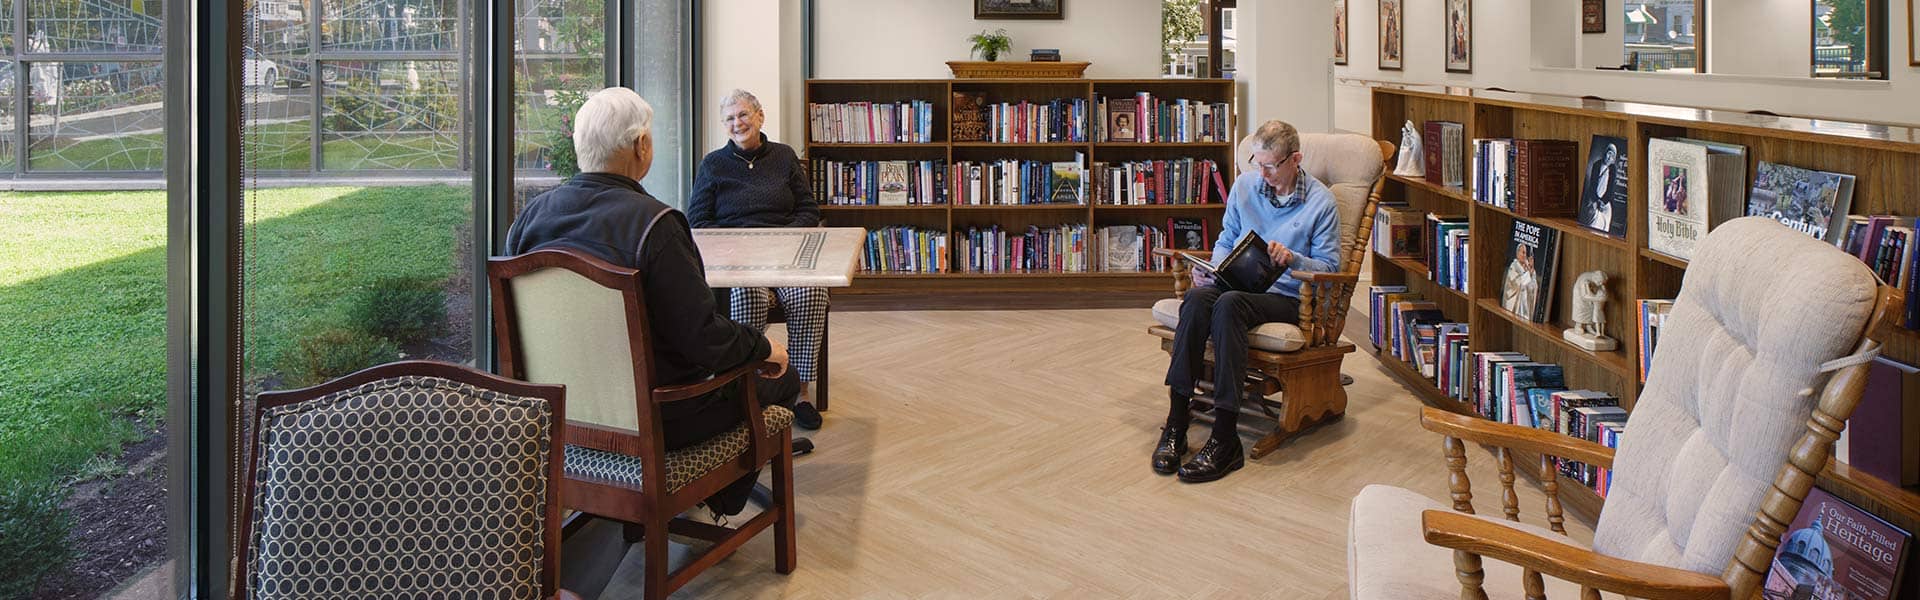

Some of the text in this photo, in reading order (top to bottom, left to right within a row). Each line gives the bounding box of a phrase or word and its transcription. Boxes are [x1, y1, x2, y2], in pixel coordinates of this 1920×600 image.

[1515, 220, 1541, 238] THE POPE
[1656, 215, 1698, 241] Holy Bible
[1514, 230, 1521, 238] IN
[1519, 231, 1540, 246] AMERICA
[1829, 507, 1847, 523] Our
[1825, 517, 1893, 565] Heritage
